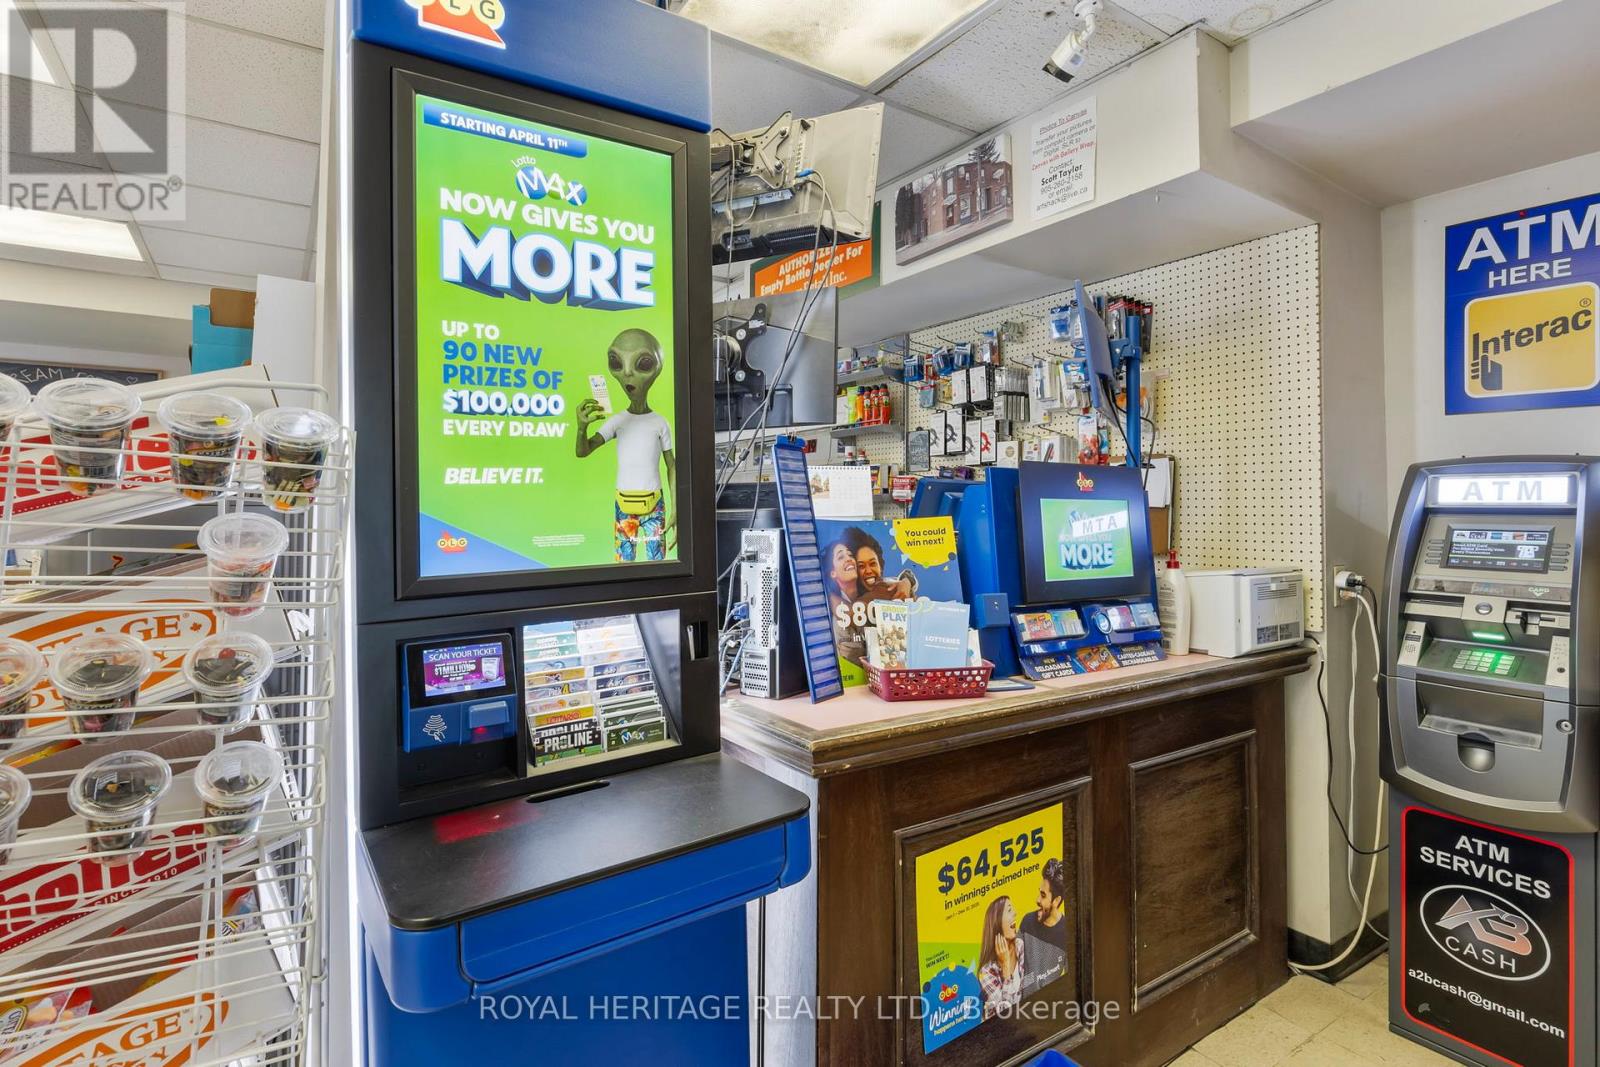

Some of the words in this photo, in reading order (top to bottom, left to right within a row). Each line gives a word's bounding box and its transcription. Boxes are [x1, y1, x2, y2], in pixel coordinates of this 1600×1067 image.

[440, 112, 505, 137] STARTING
[508, 128, 545, 147] APRIL
[511, 155, 537, 167] Lotto
[1049, 159, 1074, 174] Contact
[516, 165, 584, 207] MAX
[1041, 173, 1057, 186] Scott
[1059, 164, 1082, 178] Taylor
[1055, 183, 1073, 196] email
[440, 188, 516, 221] NOW
[522, 204, 598, 235] GIVES
[603, 217, 654, 244] YOU
[1457, 203, 1600, 271] ATM
[442, 218, 655, 308] MORE
[760, 279, 784, 297] Empty
[785, 266, 811, 285] Bottle
[846, 245, 864, 260] For
[1488, 258, 1572, 288] HERE
[830, 271, 847, 287] Inc.
[441, 320, 469, 337] UP
[473, 324, 500, 340] TO
[443, 340, 477, 360] 90
[483, 343, 542, 366] NEW
[443, 364, 527, 388] PRIZES
[532, 371, 563, 390] OF
[443, 389, 565, 416] $100,000
[443, 419, 505, 437] EVERY
[444, 467, 522, 485] BELIEVE
[525, 467, 544, 484] IT.
[1462, 480, 1543, 501] ATM
[438, 538, 467, 547] OLG
[904, 529, 922, 537] You
[922, 527, 946, 536] could
[906, 538, 921, 547] win
[922, 537, 945, 546] next!
[1060, 543, 1114, 567] MORE
[882, 612, 907, 622] PLAY
[853, 633, 861, 642] in
[925, 635, 961, 645] LOTTERIES
[428, 652, 450, 662] SCAN
[451, 649, 472, 660] YOUR
[474, 647, 497, 657] TICKET
[1034, 661, 1072, 673] RELOADABLE
[1041, 671, 1055, 679] GIFT
[1055, 669, 1075, 677] CARDS
[544, 731, 593, 753] PROLINE
[1455, 834, 1510, 864] ATM
[938, 827, 1045, 895] $64,525
[1419, 846, 1551, 900] SERVICES
[944, 899, 953, 911] in
[954, 883, 990, 906] winnings
[991, 871, 1023, 890] claimed
[1023, 863, 1040, 877] here
[1445, 936, 1516, 974] CASH
[939, 984, 959, 1000] OLG
[1408, 968, 1566, 1039] a2bcash@gmail.com
[929, 1000, 973, 1031] Winning
